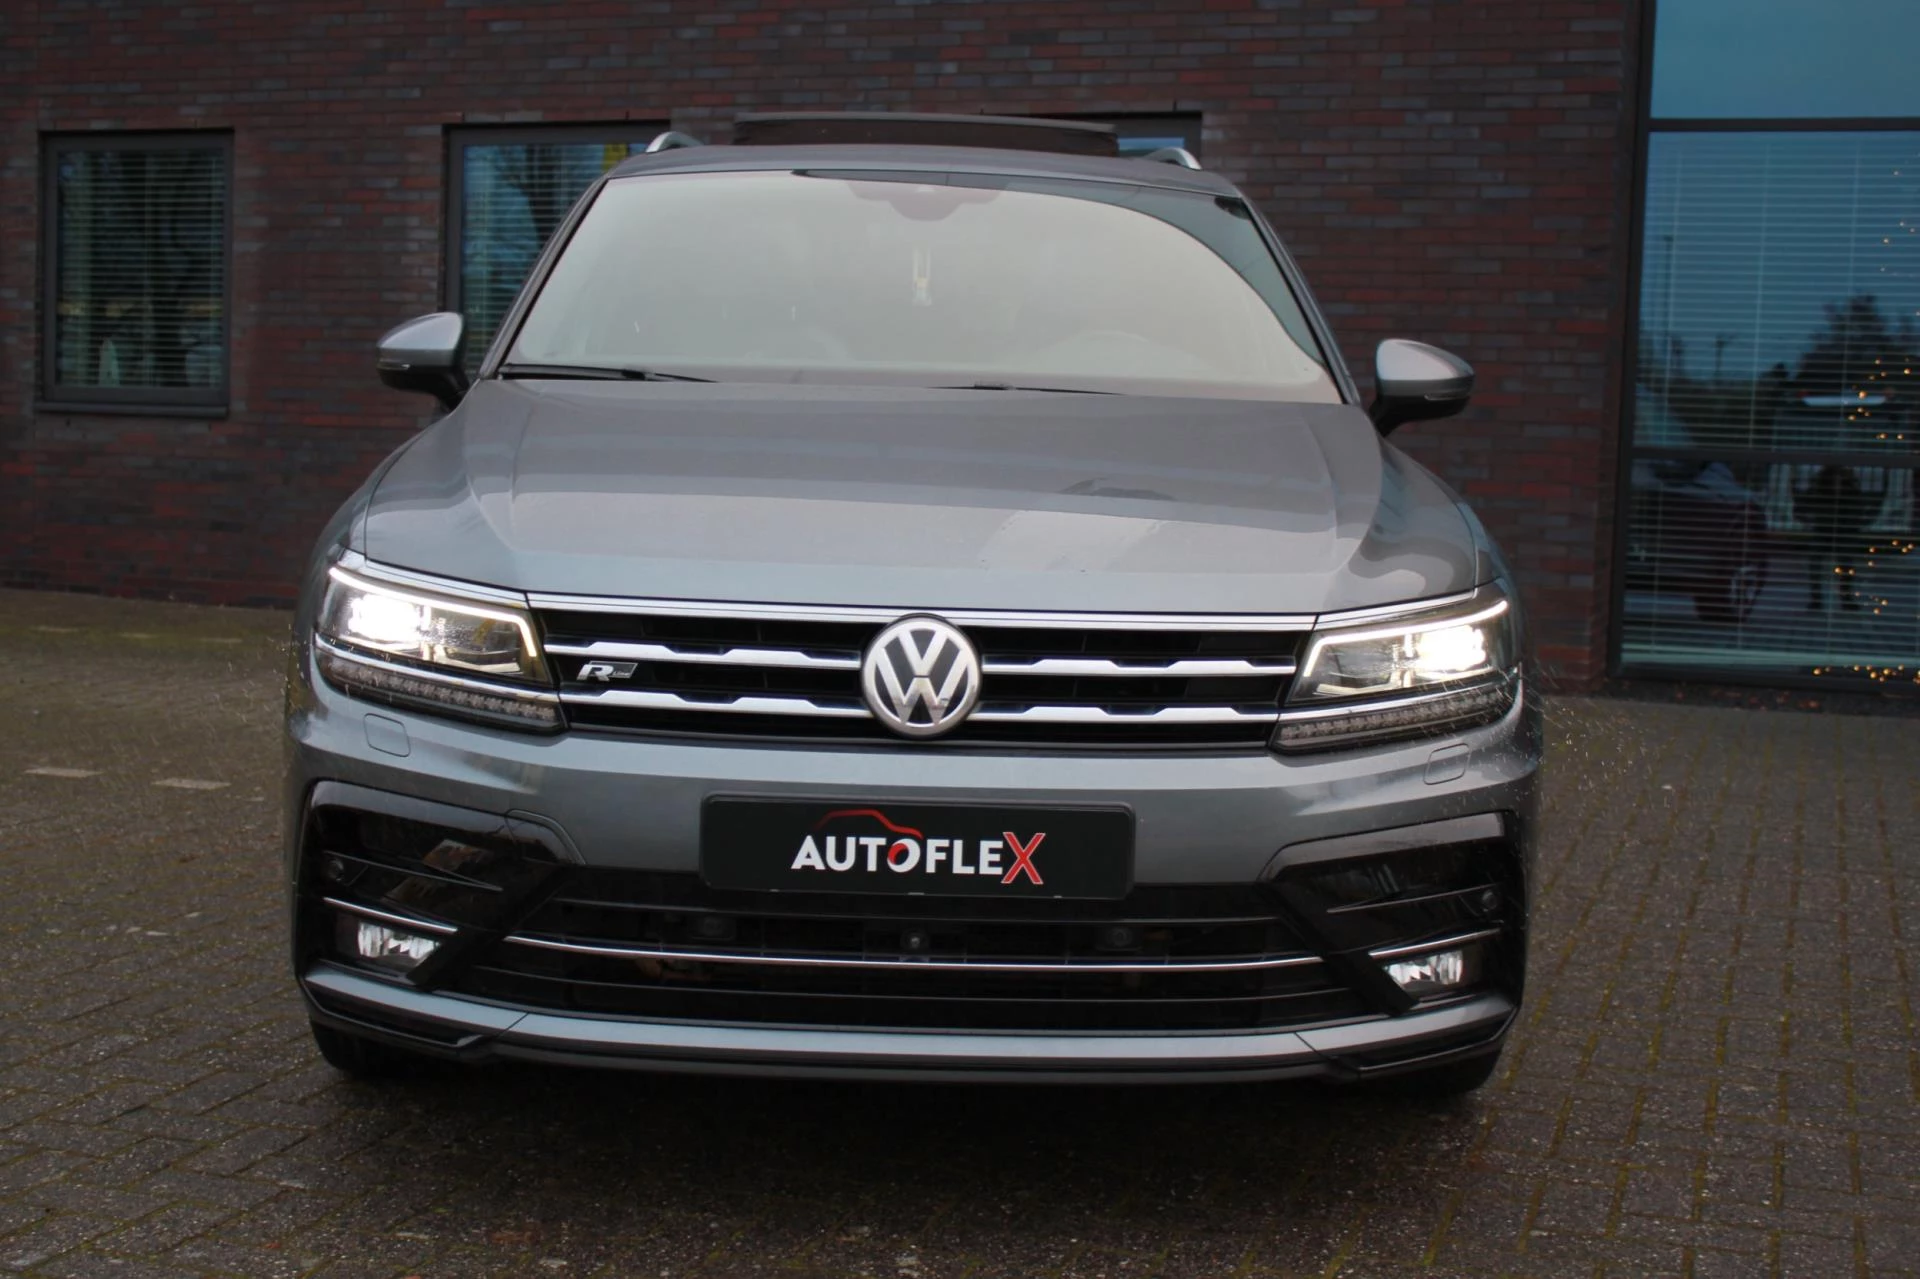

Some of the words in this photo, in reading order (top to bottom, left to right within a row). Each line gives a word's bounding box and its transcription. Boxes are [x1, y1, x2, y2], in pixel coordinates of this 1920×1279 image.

[576, 663, 614, 682] R
[868, 619, 975, 729] VW
[790, 831, 1046, 885] AUTOFLEX
